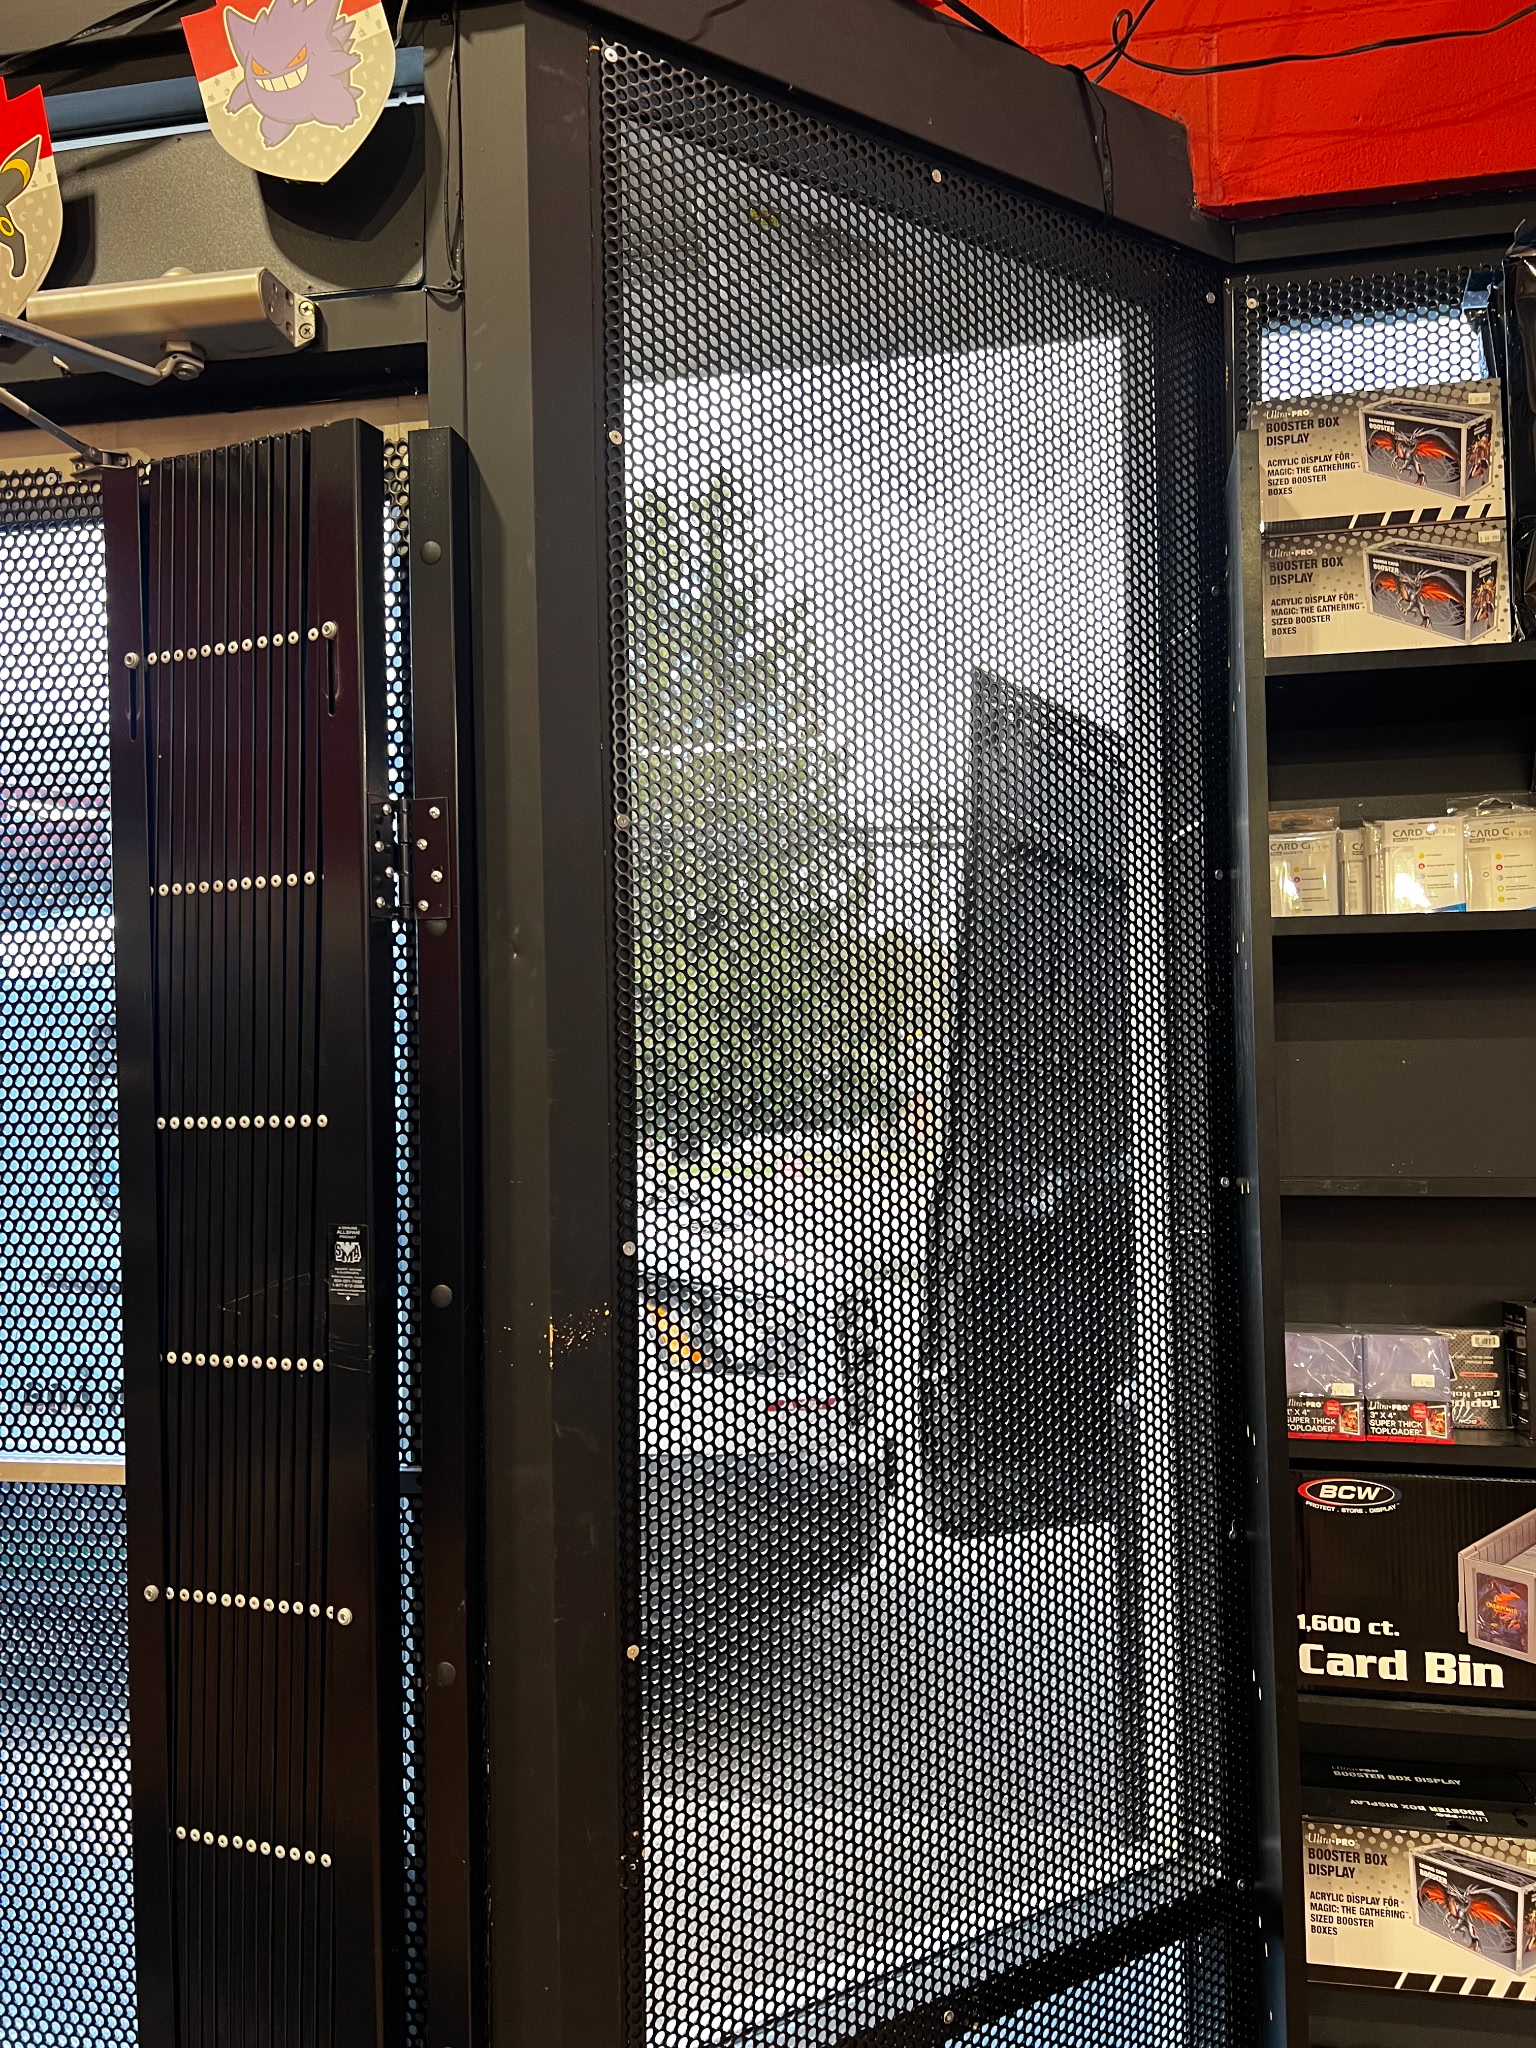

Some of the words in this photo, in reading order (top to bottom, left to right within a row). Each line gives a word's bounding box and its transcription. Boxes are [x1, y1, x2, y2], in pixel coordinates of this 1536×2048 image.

[1266, 420, 1314, 433] BOOSTER
[1318, 417, 1340, 428] BOX
[1266, 433, 1310, 446] DISPLAY
[1267, 458, 1299, 467] ACRYLIC
[1301, 454, 1332, 465] DISPLAY
[1335, 453, 1350, 461] FOR
[1267, 469, 1295, 477] MAGIC:
[1296, 466, 1310, 474] THE
[1268, 478, 1289, 486] SIZED
[1292, 475, 1327, 485] BOOSTER
[1268, 487, 1293, 496] BOXES
[1270, 559, 1318, 572] BOOSTER
[1321, 557, 1344, 567] BOX
[1269, 572, 1313, 586] DISPLAY
[1271, 597, 1302, 606] ACRYLIC
[1305, 595, 1336, 604] DISPLAY
[1339, 593, 1354, 601] FOR
[1271, 608, 1298, 616] MAGIC:
[1300, 606, 1314, 614] THE
[1271, 617, 1293, 626] SIZED
[1295, 614, 1331, 624] BOOSTER
[1272, 627, 1297, 635] BOXES
[1393, 829, 1423, 838] CARD
[1469, 828, 1500, 838] CARD
[1270, 842, 1298, 851] CARD
[1369, 1419, 1395, 1427] SUPER
[1398, 1420, 1423, 1428] THICK
[1370, 1427, 1421, 1436] TOPLOADER
[1319, 1484, 1380, 1500] BCW
[1305, 1500, 1335, 1512] PROTECT
[1369, 1504, 1396, 1514] DISPLAY
[1297, 1613, 1361, 1634] 1,600
[1368, 1620, 1400, 1636] ct.
[1299, 1643, 1408, 1681] Card
[1425, 1651, 1504, 1688] Bin
[1333, 1770, 1385, 1780] BOOSTER
[1388, 1774, 1412, 1782] BOX
[1414, 1776, 1461, 1785] DISPLAY
[1350, 1799, 1399, 1809] DISPLAY
[1429, 1806, 1485, 1816] BOOSTER
[1308, 1848, 1360, 1864] BOOSTER
[1364, 1853, 1388, 1866] BOX
[1308, 1863, 1355, 1878] DISPLAY
[1310, 1891, 1344, 1902] ACRYLIC
[1347, 1895, 1380, 1905] DISPLAY
[1383, 1898, 1399, 1907] FOR
[1310, 1902, 1339, 1913] MAGIC:
[1341, 1906, 1356, 1914] THE
[1310, 1914, 1334, 1923] SIZED
[1337, 1916, 1374, 1927] BOOSTER
[1311, 1925, 1338, 1935] BOXES
